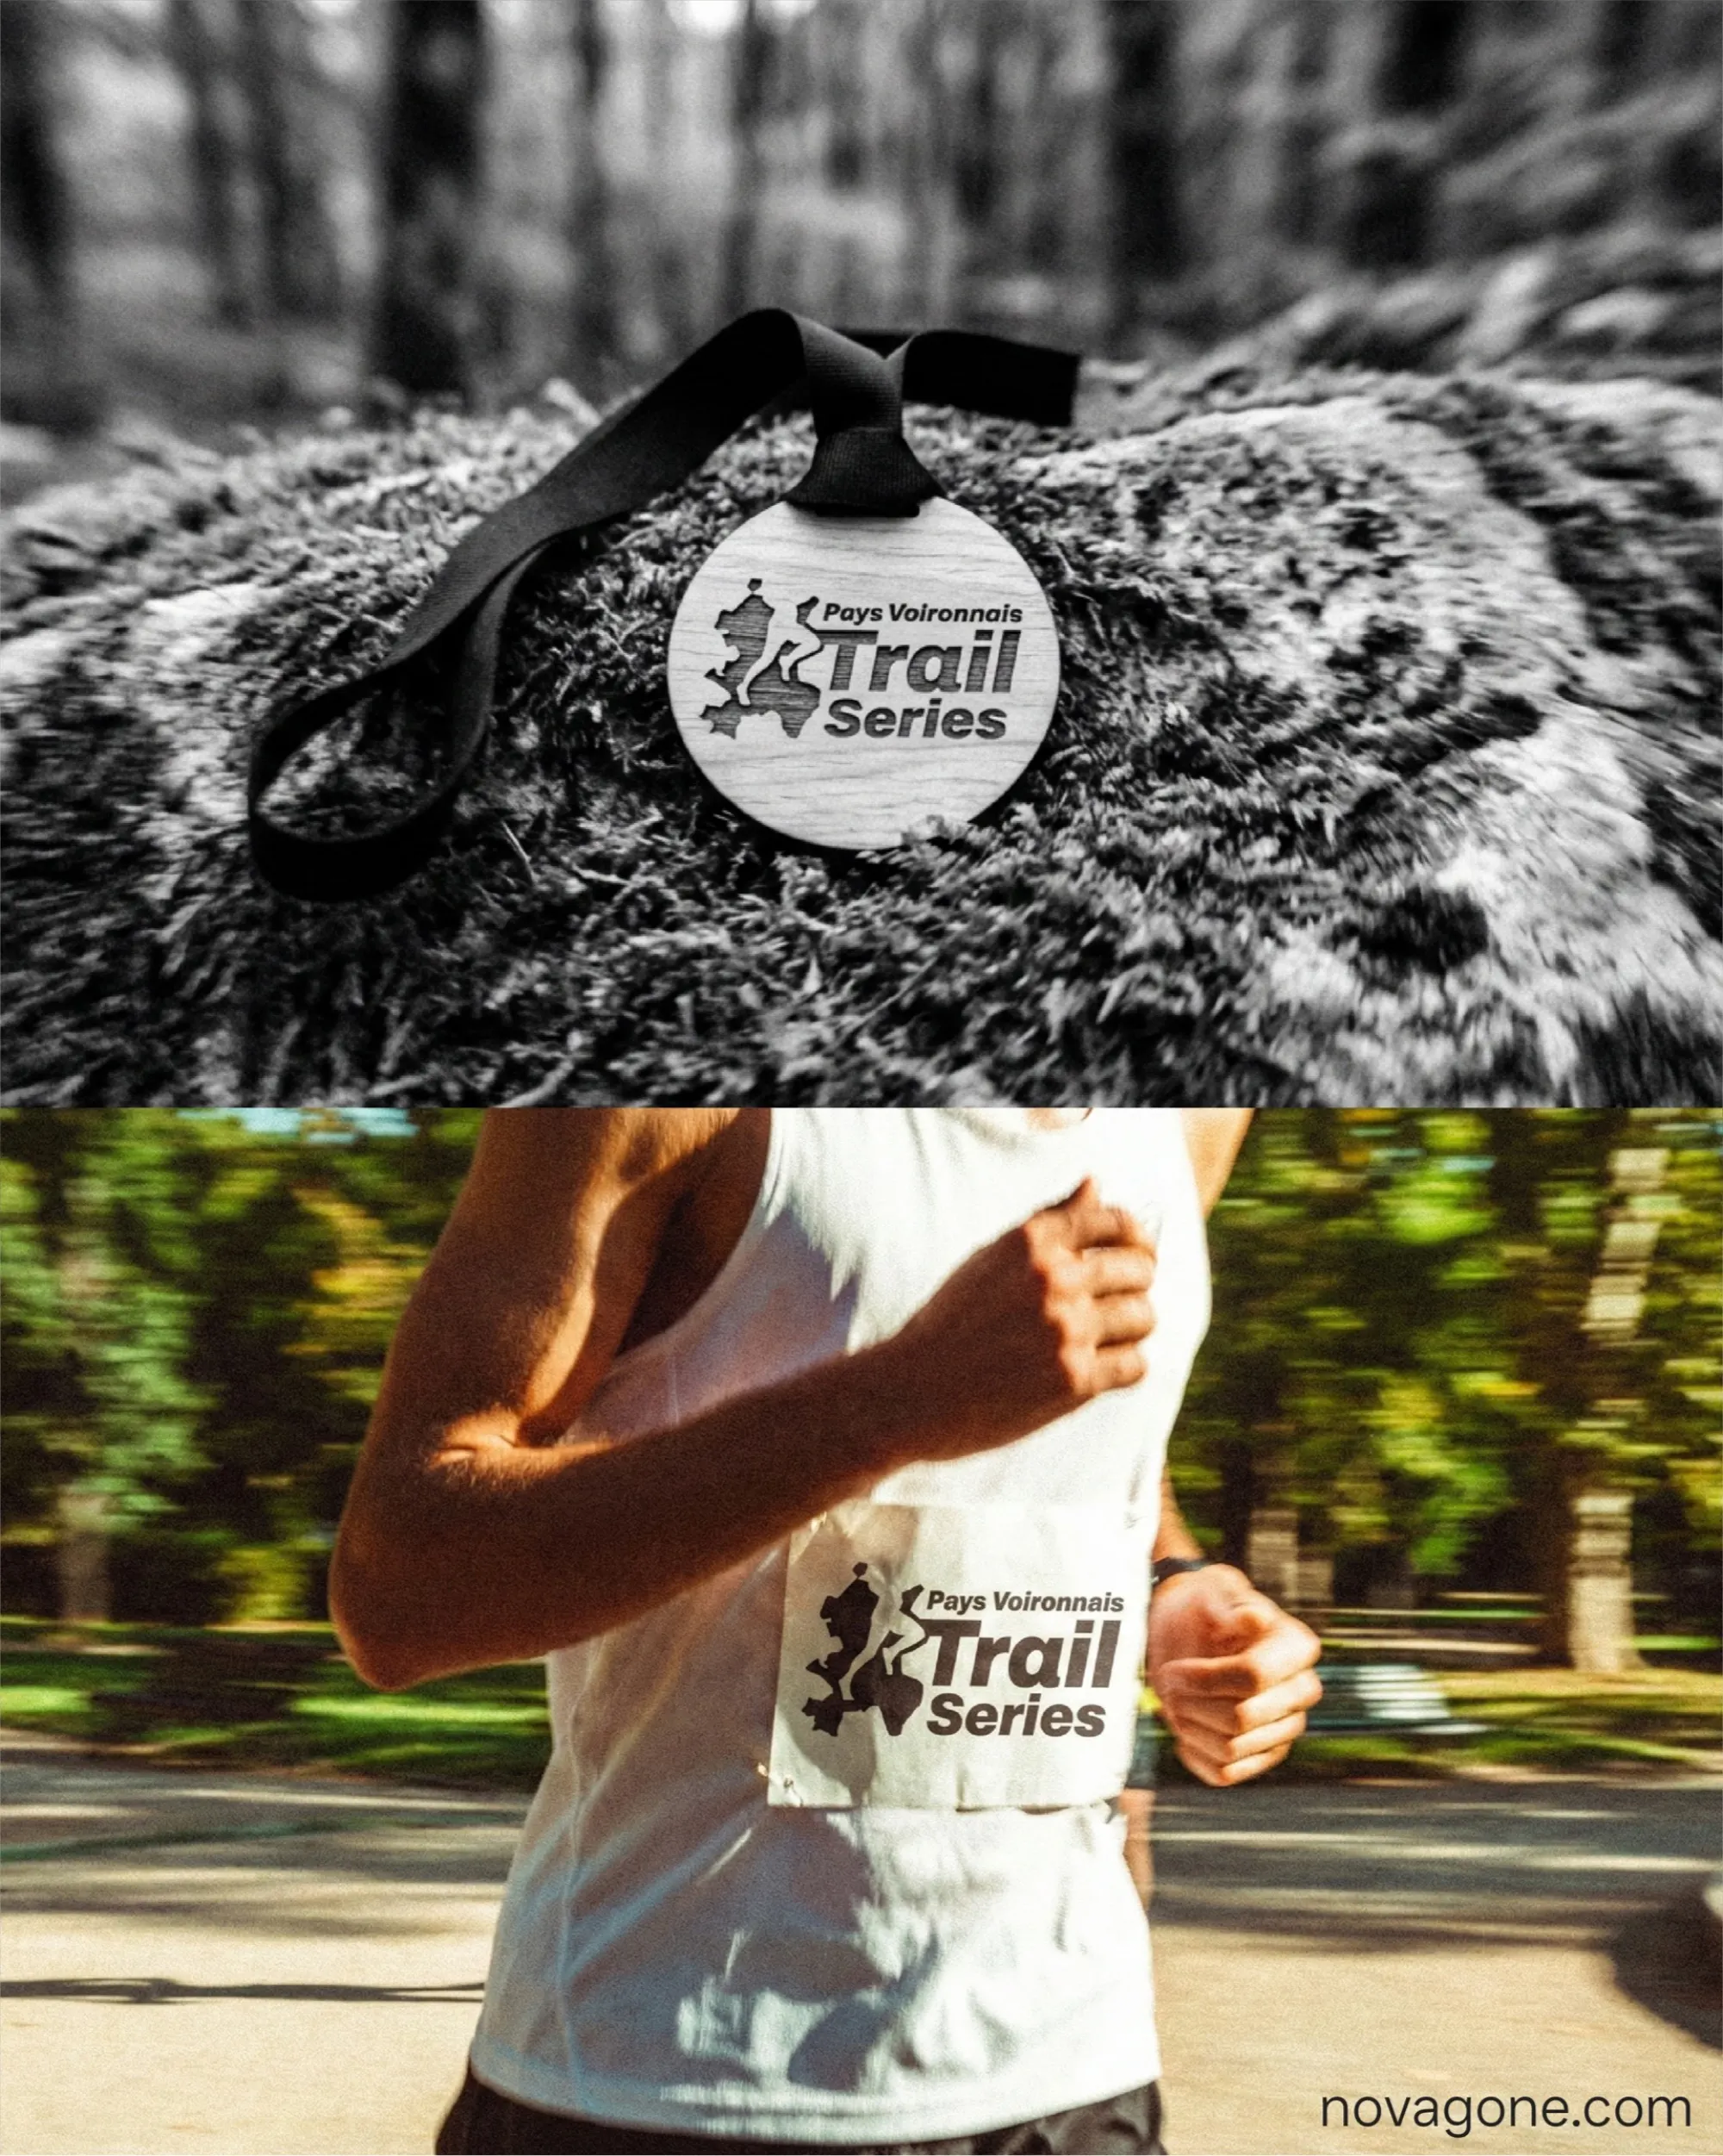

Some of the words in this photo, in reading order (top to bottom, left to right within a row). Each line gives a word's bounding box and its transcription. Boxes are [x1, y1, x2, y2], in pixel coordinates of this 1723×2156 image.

[823, 603, 883, 626] Pays
[889, 603, 1023, 622] Voironnais
[816, 629, 1022, 693] Trail
[824, 697, 1007, 739] Series
[926, 1590, 986, 1616] Pays
[992, 1591, 1124, 1612] Voironnais
[920, 1619, 1122, 1688] Trail
[926, 1692, 1106, 1737] Series
